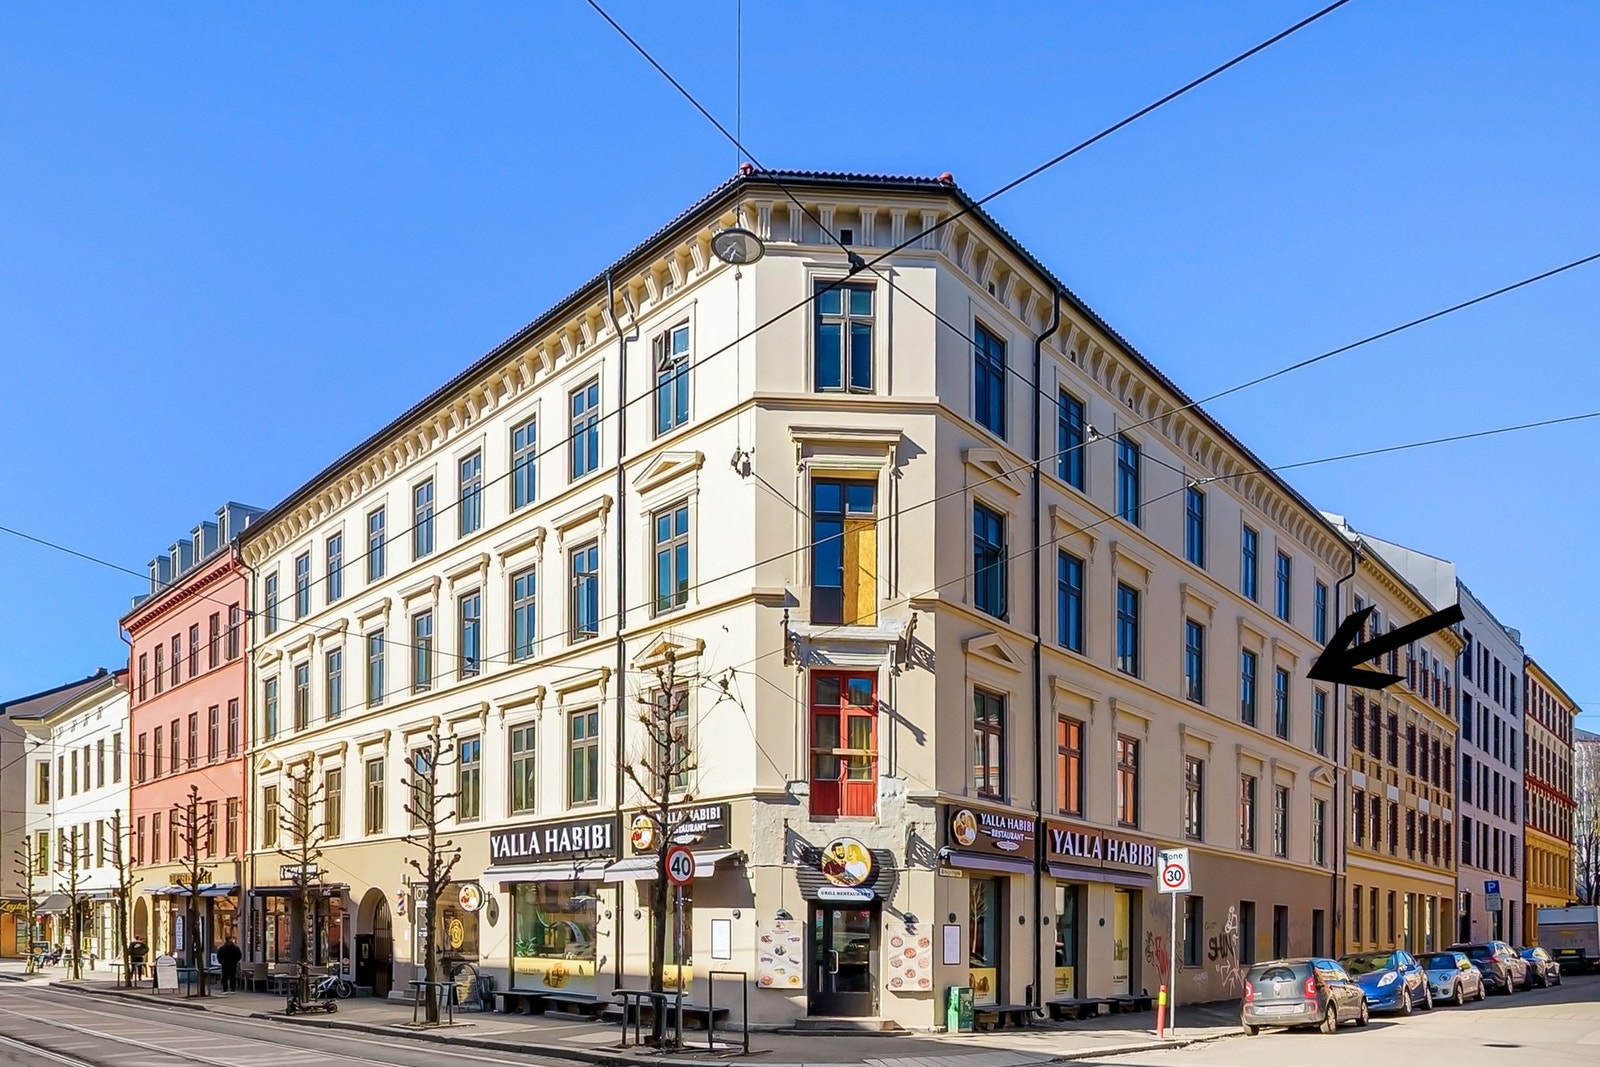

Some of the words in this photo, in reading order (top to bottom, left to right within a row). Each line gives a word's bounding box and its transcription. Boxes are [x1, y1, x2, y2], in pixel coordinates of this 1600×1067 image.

[656, 810, 685, 826] YLLA
[981, 813, 1006, 829] YALLA
[1007, 818, 1035, 833] HABIBI
[491, 831, 541, 858] YALLA
[545, 823, 611, 853] HABIBI
[991, 829, 1025, 841] RESTAURANT
[1053, 829, 1102, 860] YALLA
[1107, 838, 1156, 867] HABIBI
[671, 857, 691, 876] 40
[1167, 870, 1182, 882] 30
[1487, 882, 1496, 892] P
